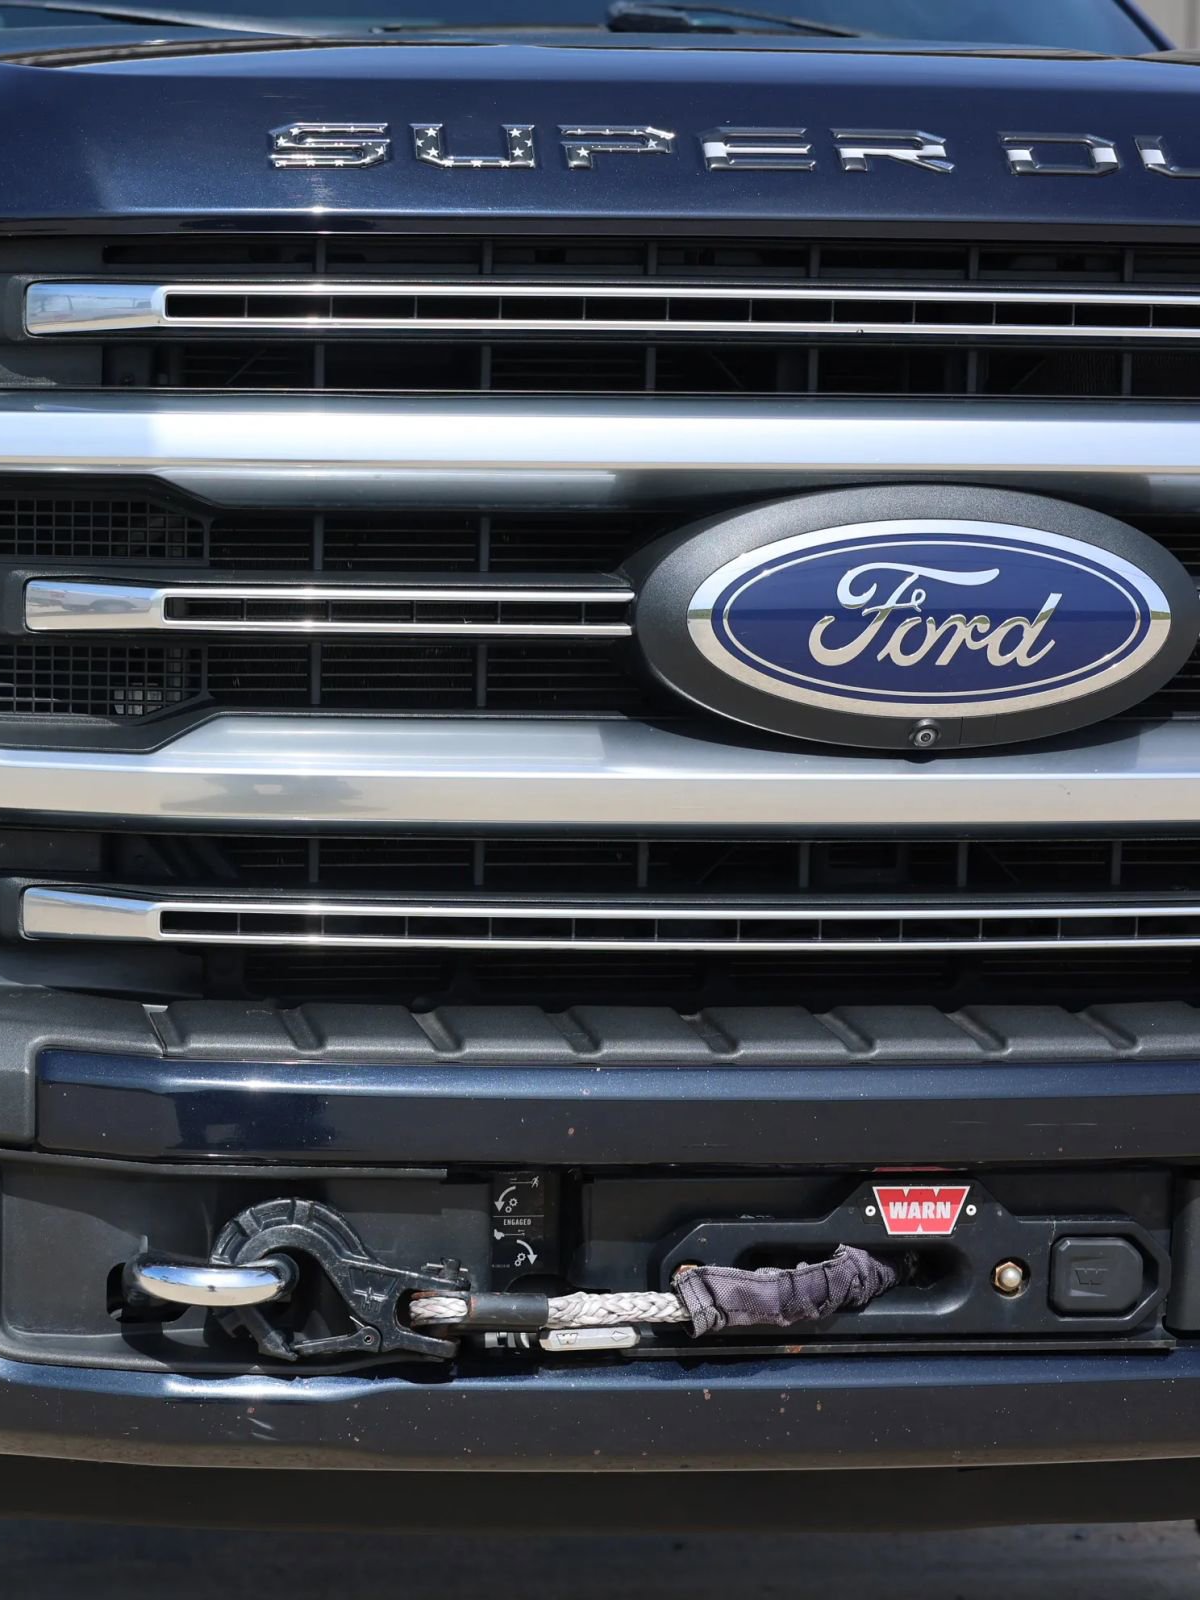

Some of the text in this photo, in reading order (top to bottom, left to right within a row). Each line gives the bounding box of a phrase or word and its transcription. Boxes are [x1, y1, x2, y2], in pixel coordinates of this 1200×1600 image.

[269, 122, 955, 173] SUPER
[808, 561, 1063, 667] Ford
[503, 1218, 532, 1226] ENGAGED
[888, 1201, 951, 1219] WARN
